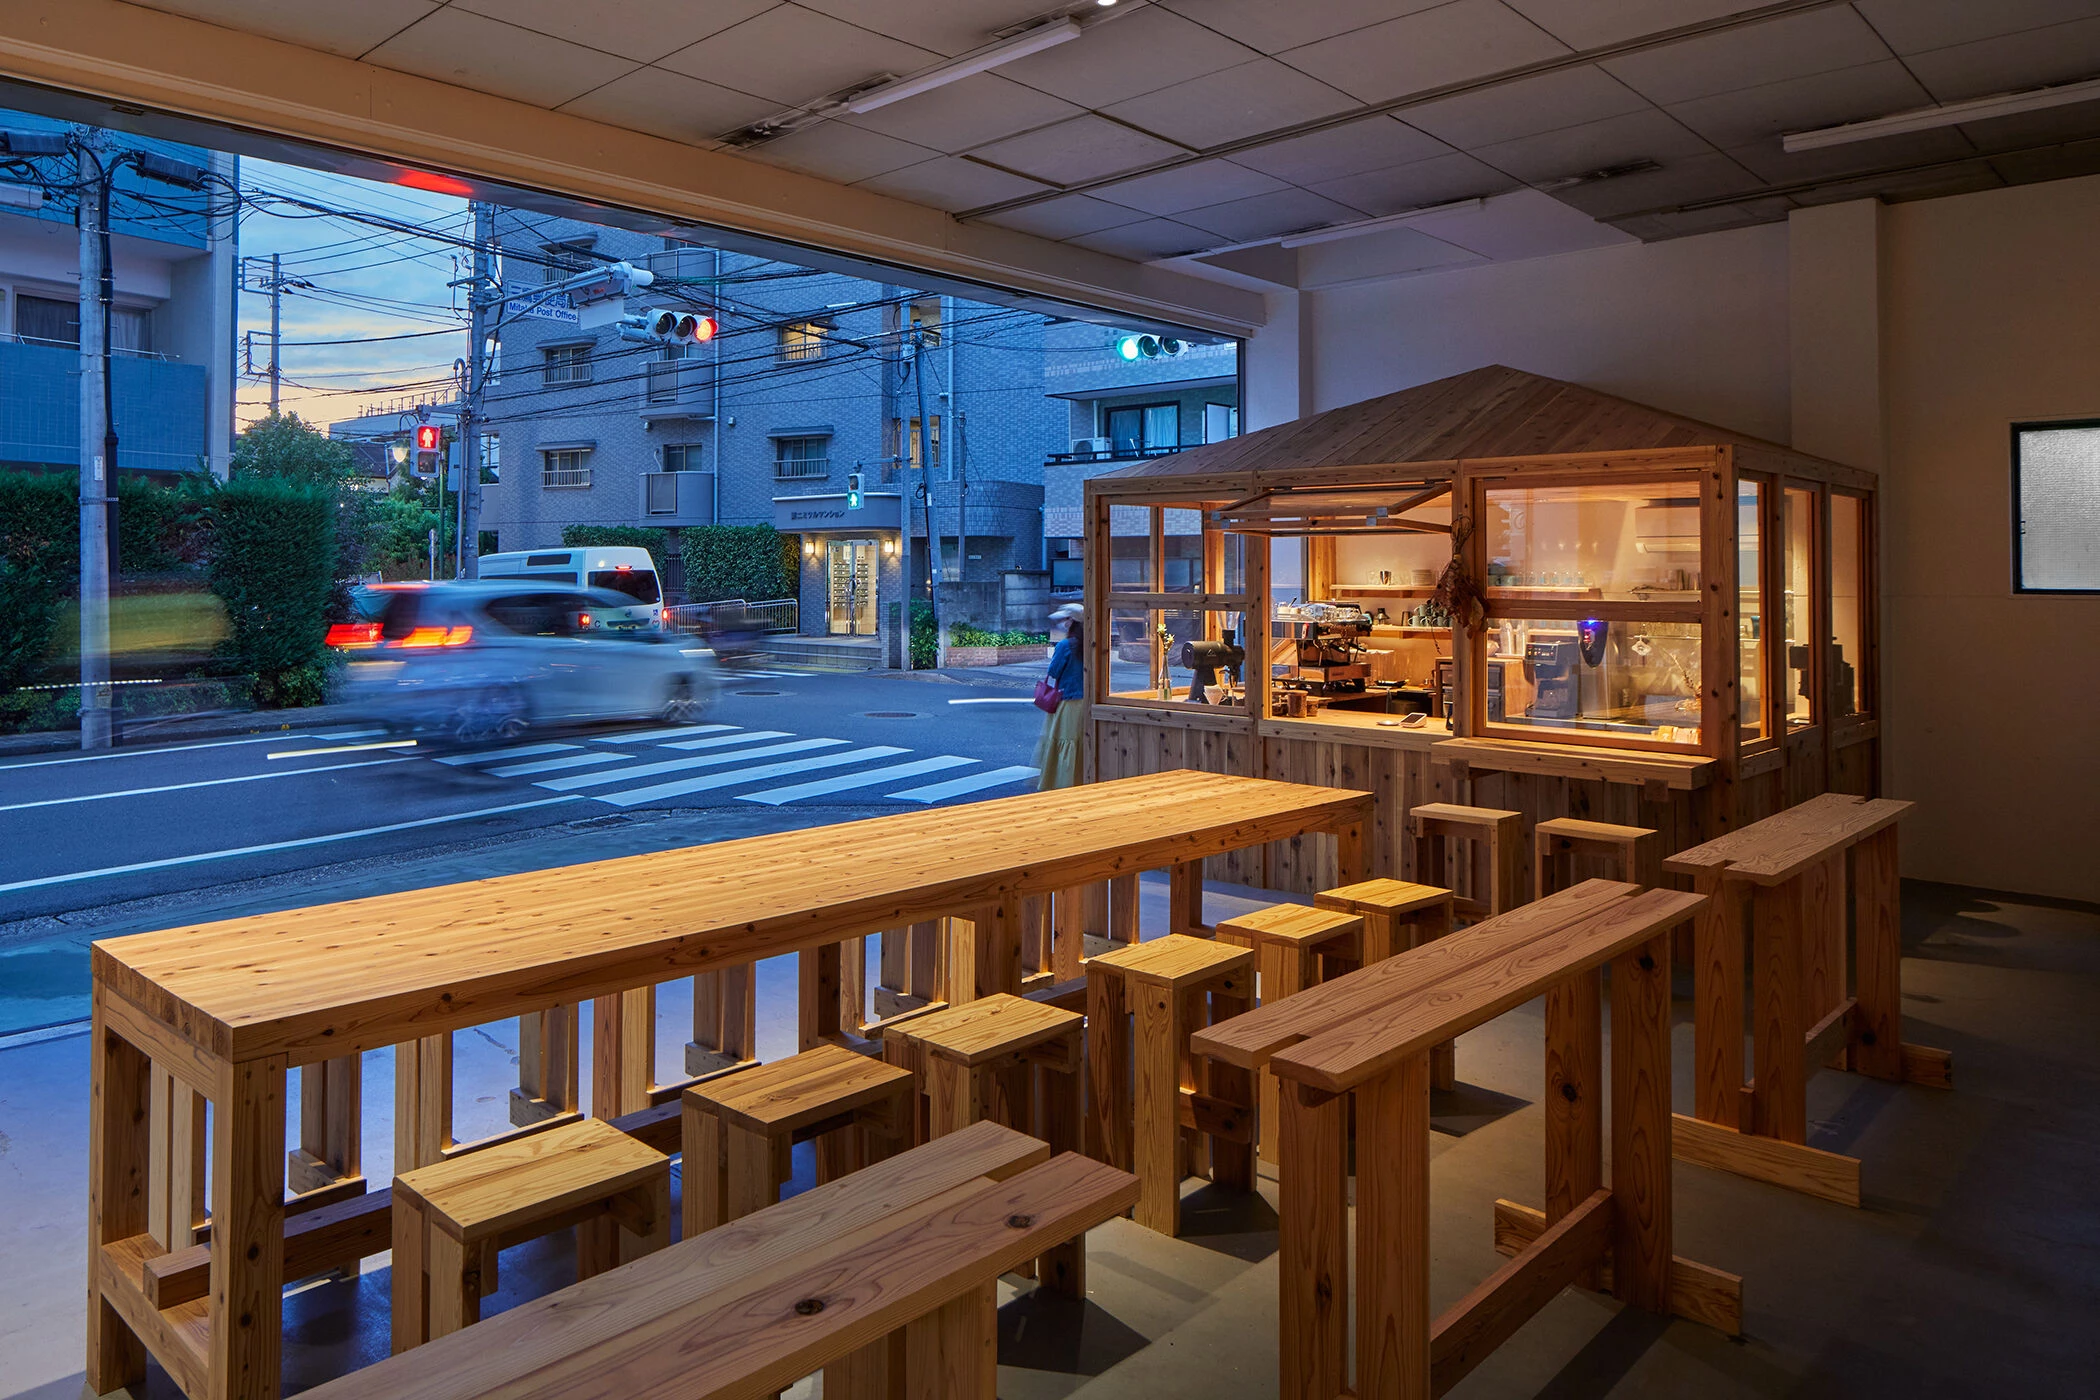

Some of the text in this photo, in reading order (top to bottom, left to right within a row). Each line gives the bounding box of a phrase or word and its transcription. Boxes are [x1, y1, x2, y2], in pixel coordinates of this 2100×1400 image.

[509, 302, 577, 321] Mitaa Post Office
